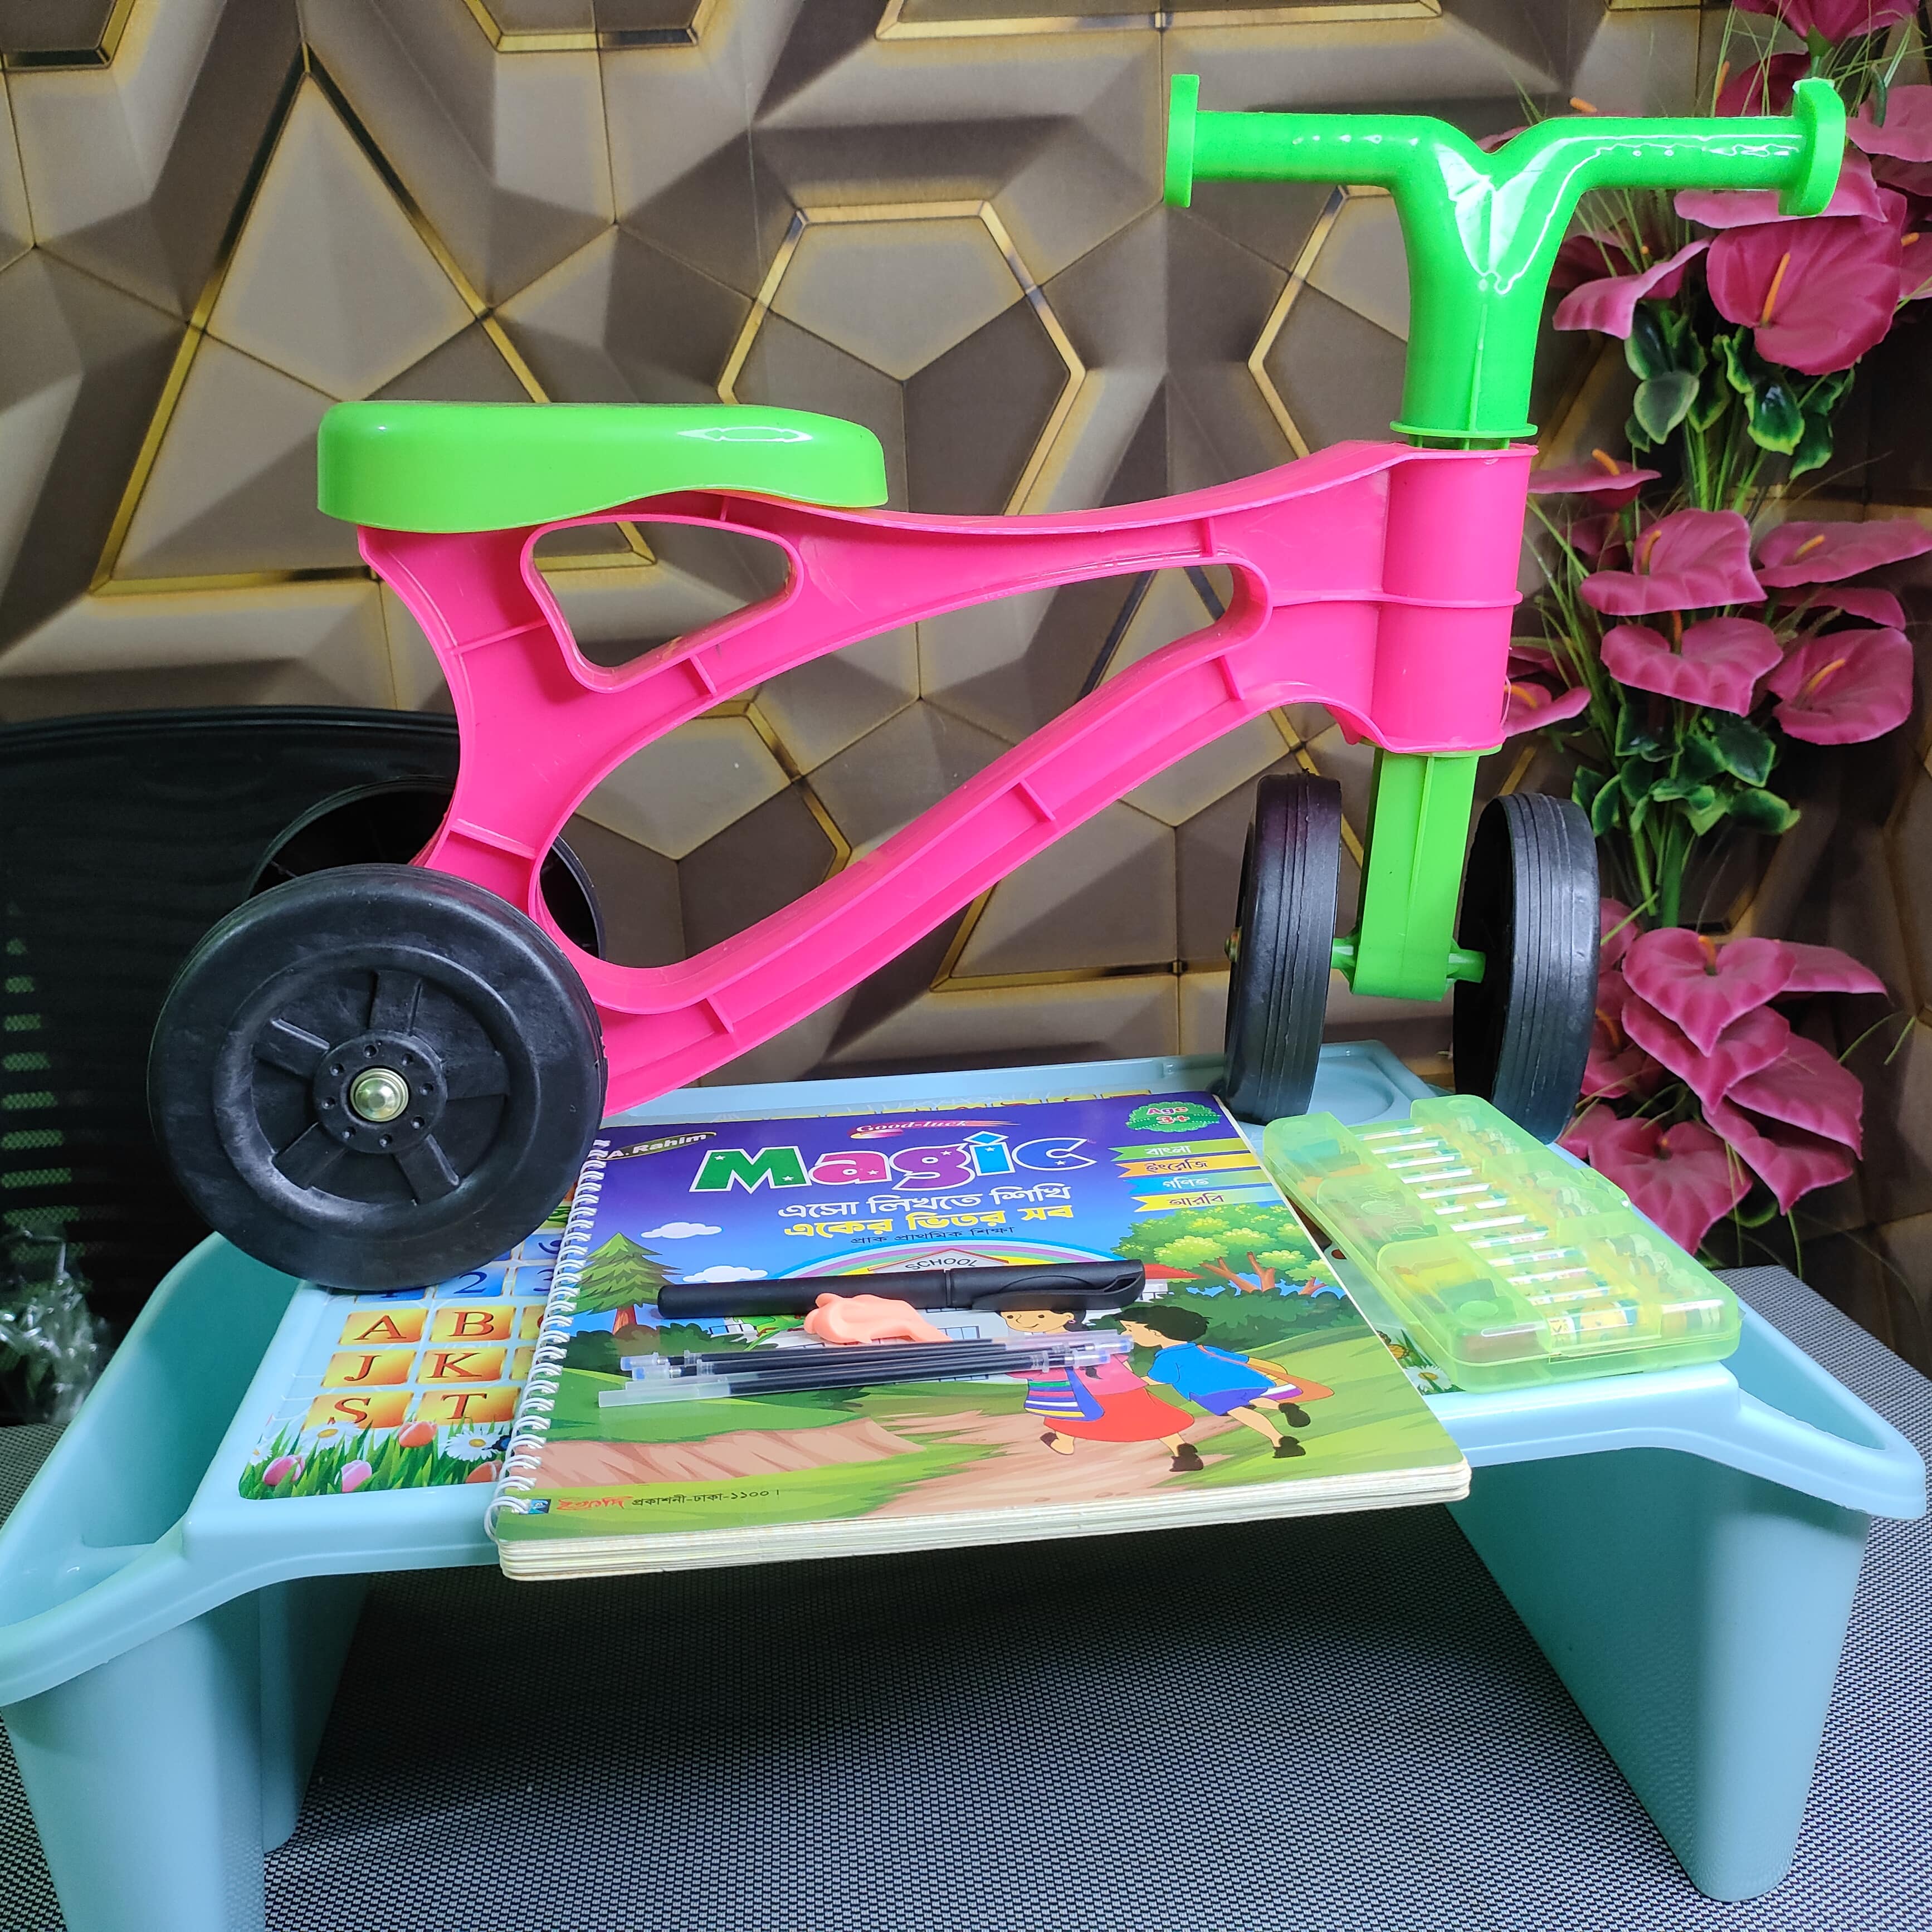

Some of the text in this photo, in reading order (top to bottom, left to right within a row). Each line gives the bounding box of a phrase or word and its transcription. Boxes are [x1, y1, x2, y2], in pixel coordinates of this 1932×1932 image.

[1146, 1106, 1189, 1115] Age
[1155, 1115, 1191, 1124] 3+
[856, 1120, 969, 1133] Good-luck
[632, 1134, 706, 1154] Rahim
[1144, 1145, 1192, 1156] বাংলা
[689, 1130, 1097, 1194] Magic
[1144, 1158, 1208, 1173] ইংরেজি
[1163, 1177, 1209, 1189] গণিত
[778, 1182, 1072, 1218] এসো লিখতে শিখি
[1167, 1193, 1224, 1206] আরবি
[784, 1205, 1074, 1238] একের ভিতর সব
[850, 1226, 1016, 1244] প্রাক প্রাথমিক শিক্ষা
[905, 1257, 978, 1270] SCHOOL
[453, 1271, 488, 1295] 2
[354, 1311, 495, 1340] A B
[344, 1352, 482, 1382] J K
[327, 1393, 488, 1424] S T
